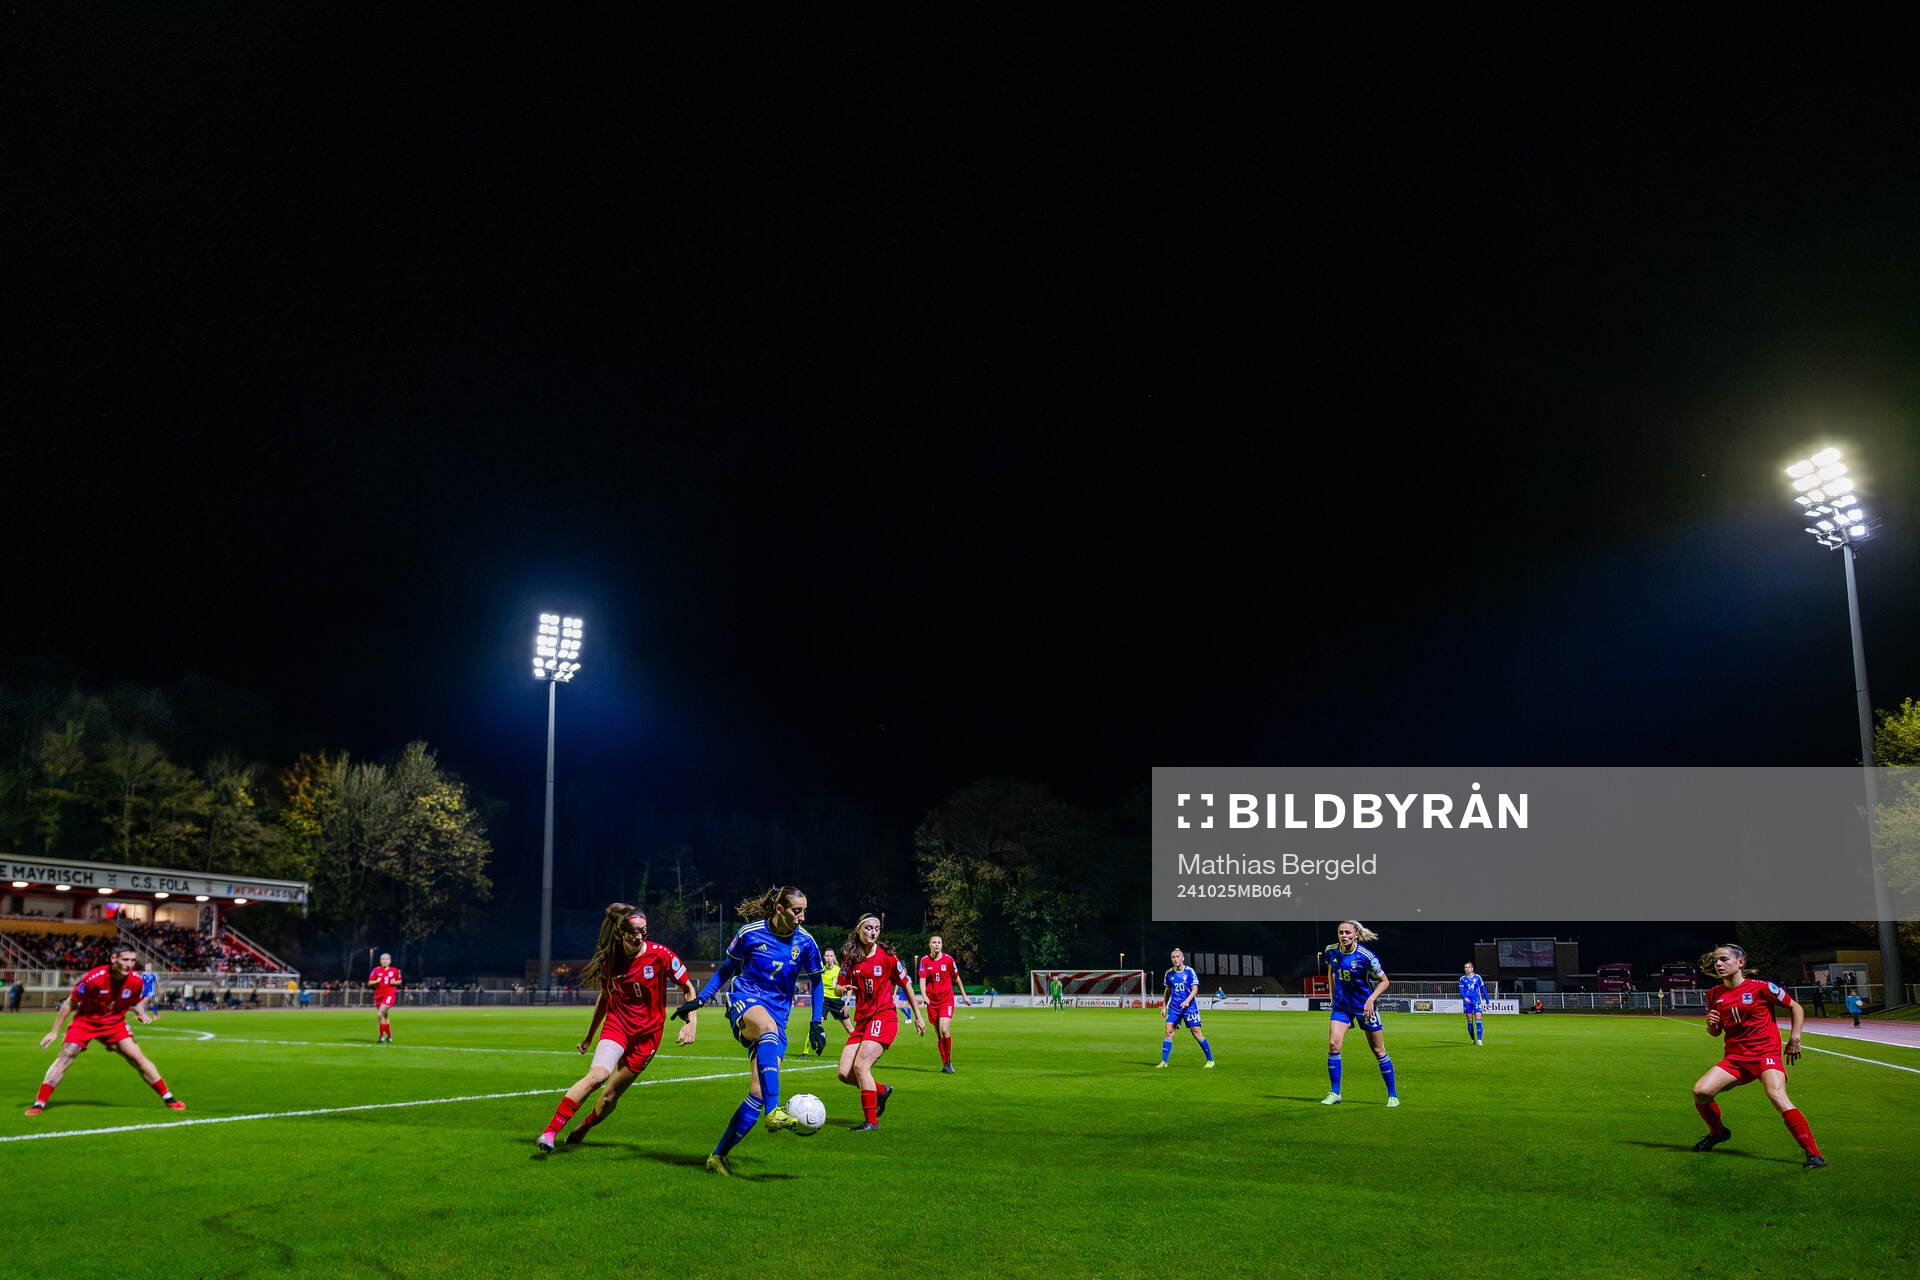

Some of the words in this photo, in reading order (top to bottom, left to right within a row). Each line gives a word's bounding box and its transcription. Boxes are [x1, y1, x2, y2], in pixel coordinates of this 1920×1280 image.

[12, 865, 94, 884] MAYRISCH
[131, 876, 156, 890] C.S.
[159, 878, 190, 892] FOLA
[772, 960, 784, 980] 7
[1337, 968, 1351, 981] 18
[1174, 982, 1186, 992] 20
[1731, 1006, 1742, 1023] 11
[870, 1020, 882, 1037] 13
